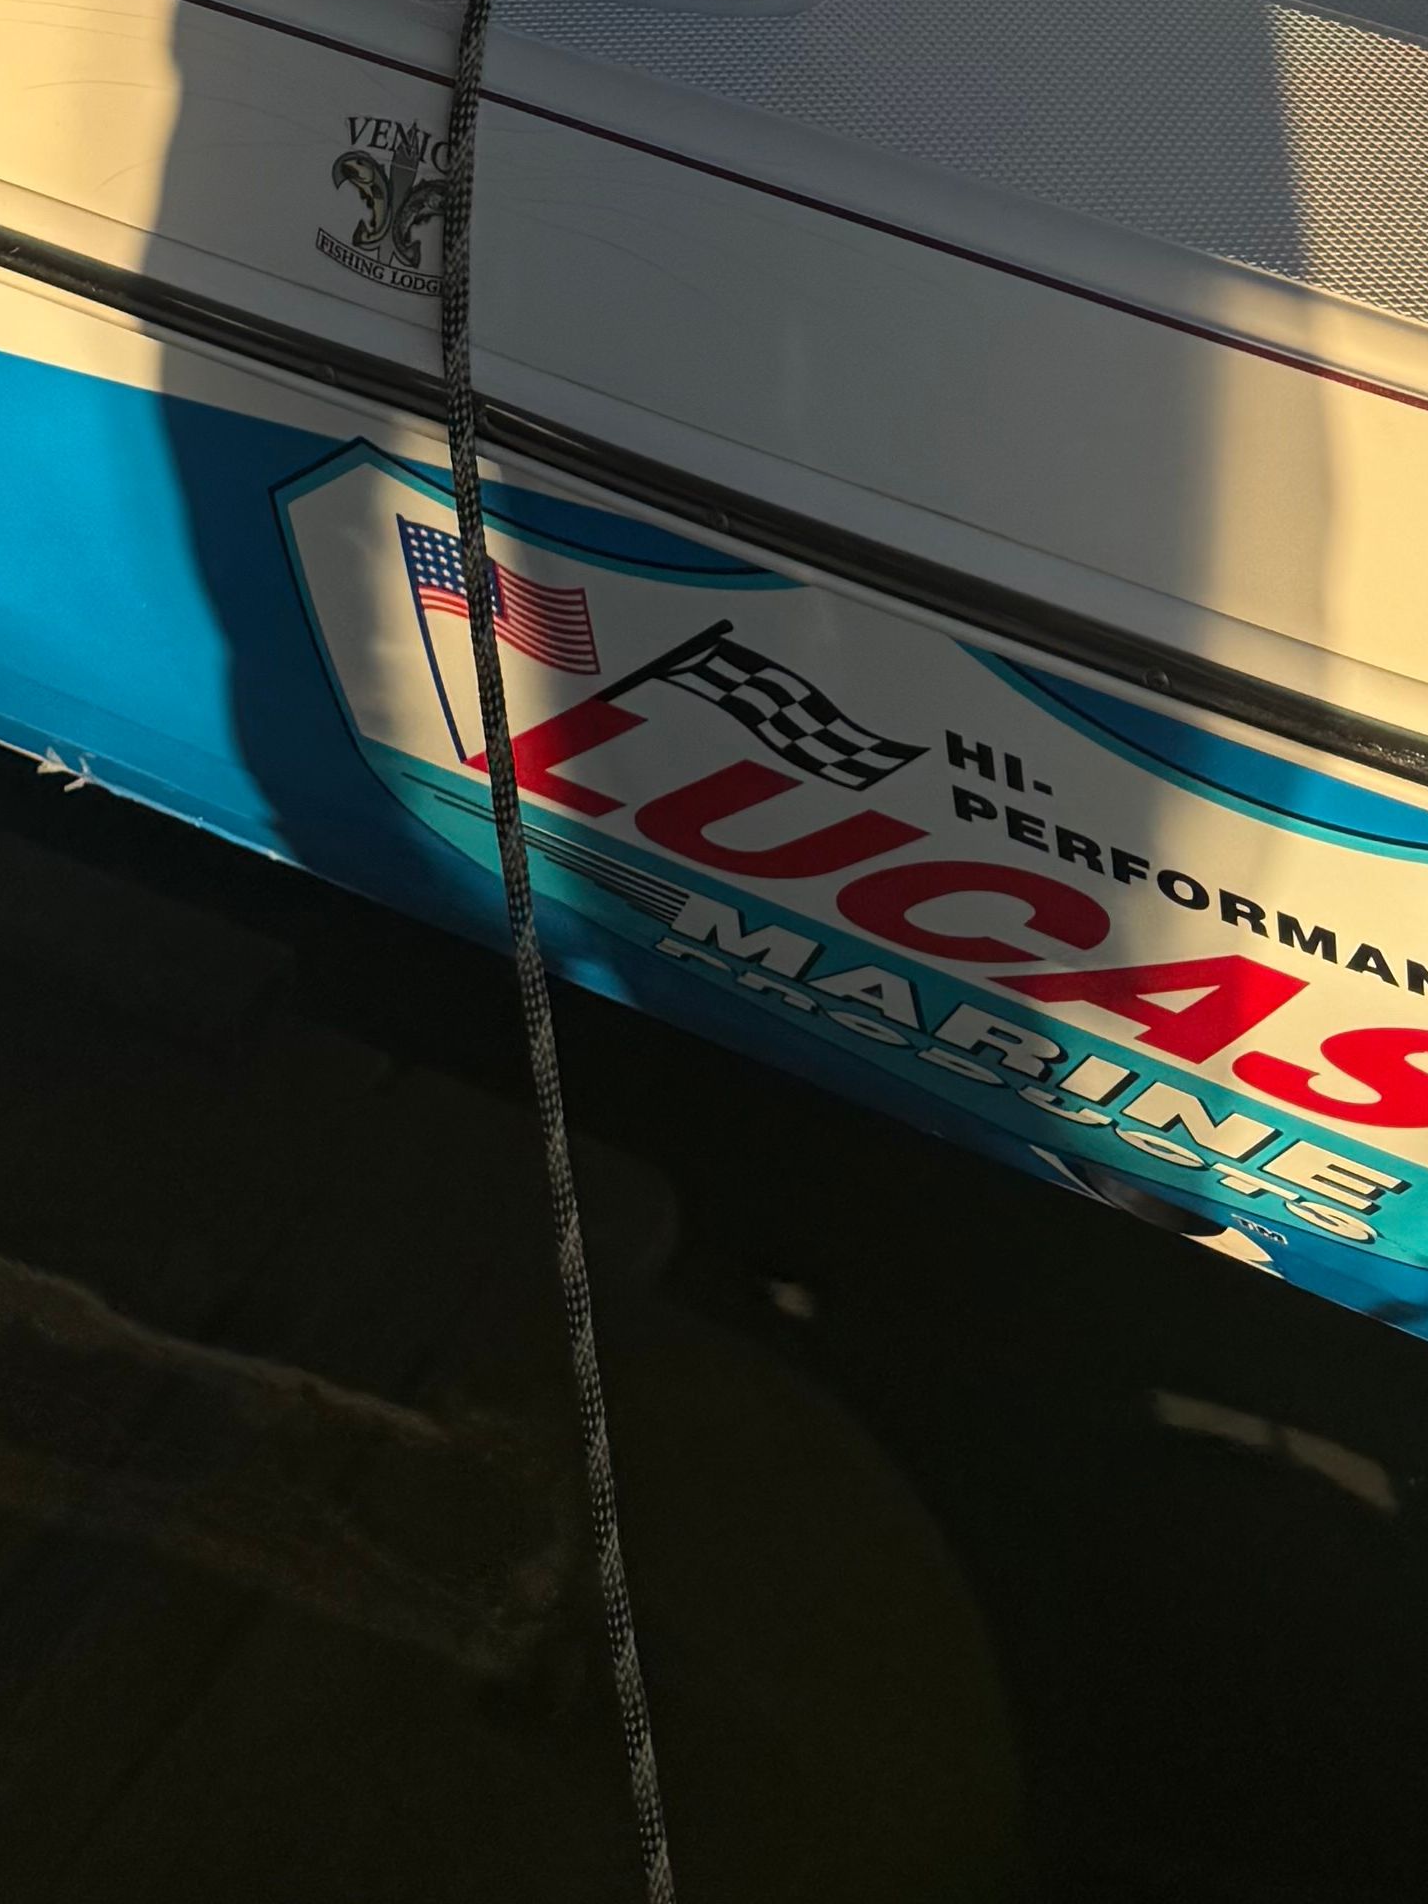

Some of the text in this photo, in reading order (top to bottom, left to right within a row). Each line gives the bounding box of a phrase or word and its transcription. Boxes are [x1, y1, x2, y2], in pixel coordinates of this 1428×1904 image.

[347, 116, 452, 175] VENIC
[319, 235, 444, 295] FISHING LODG
[944, 729, 1054, 797] HI-
[670, 892, 1412, 1216] MARINE
